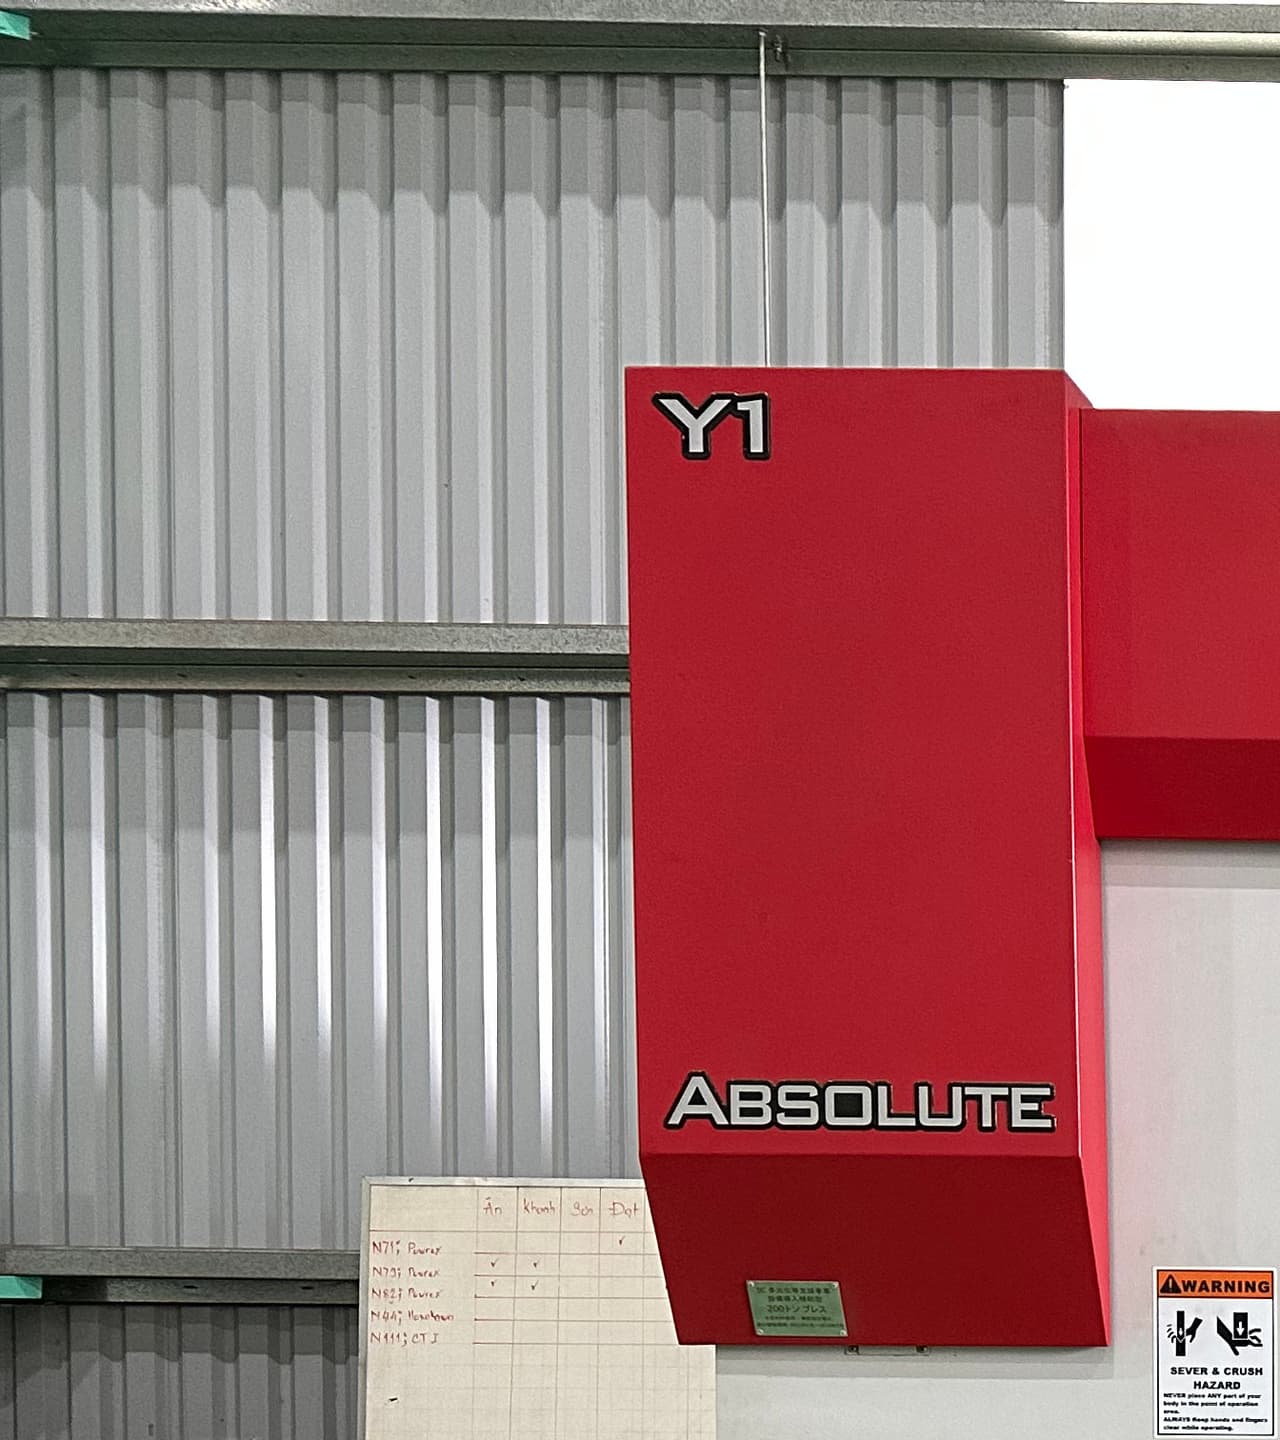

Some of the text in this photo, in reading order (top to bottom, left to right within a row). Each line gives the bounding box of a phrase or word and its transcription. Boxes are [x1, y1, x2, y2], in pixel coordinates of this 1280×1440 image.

[652, 391, 771, 461] Y1
[663, 1071, 1057, 1133] ABSOLUTE
[1181, 1279, 1270, 1294] WARNING
[1170, 1366, 1263, 1376] SEVER & CRUSH
[1193, 1381, 1241, 1390] HAZARD
